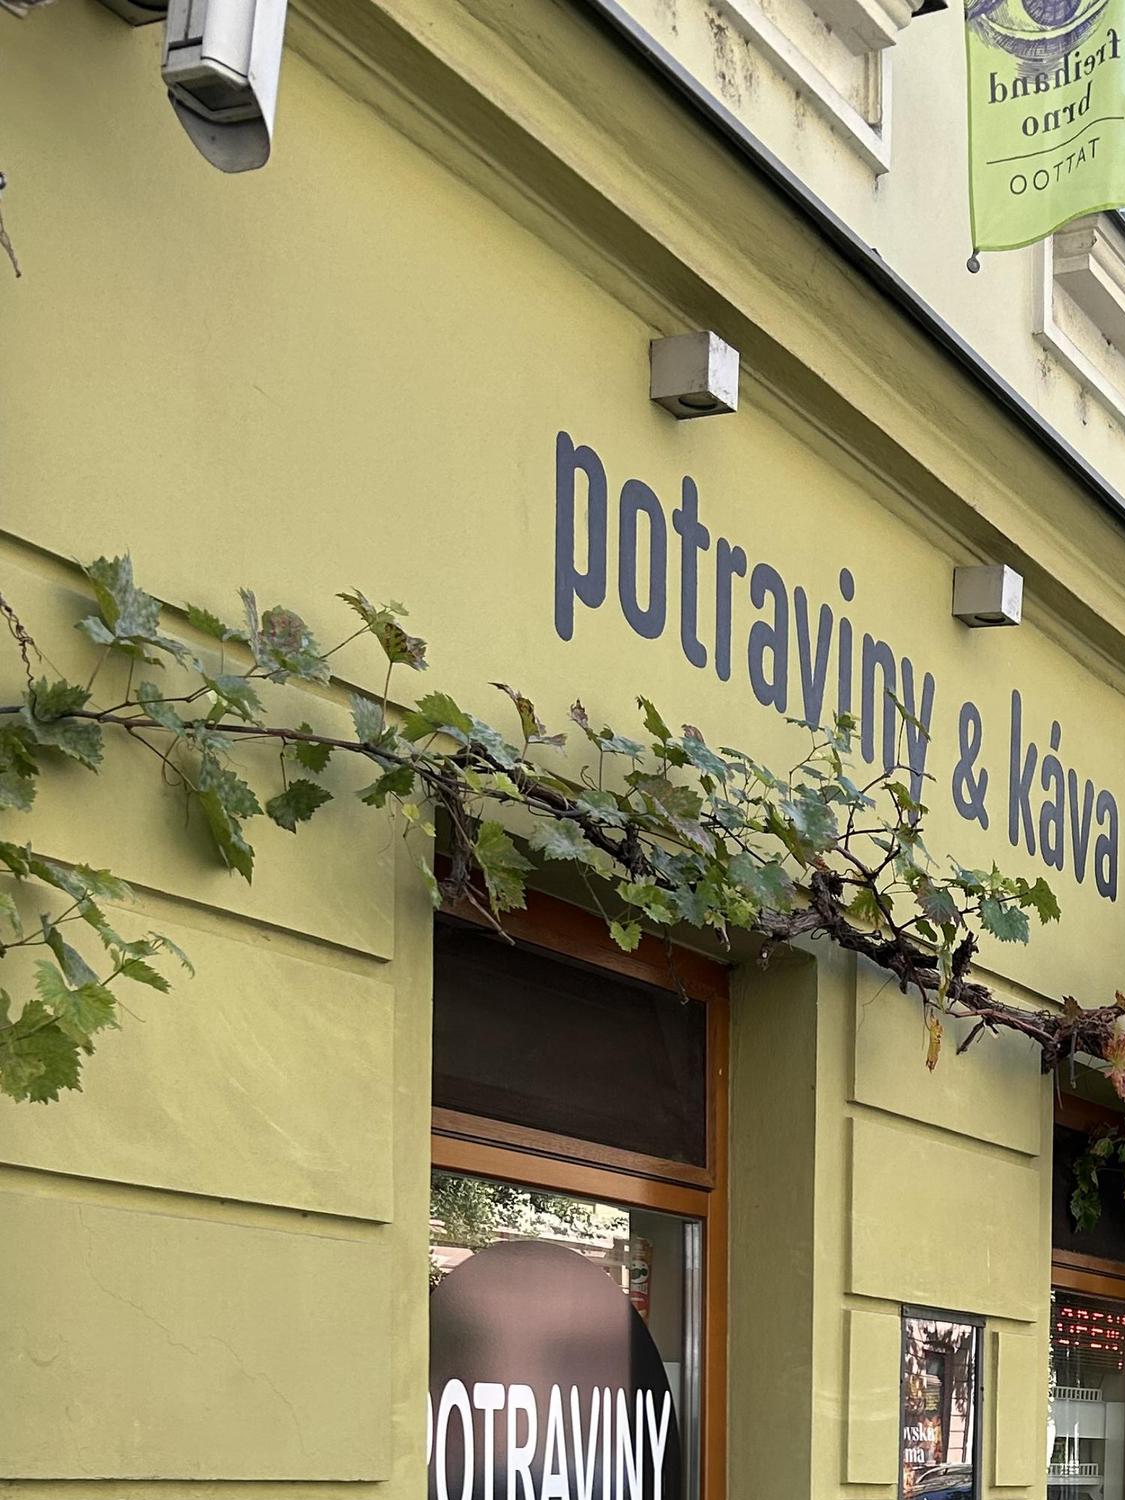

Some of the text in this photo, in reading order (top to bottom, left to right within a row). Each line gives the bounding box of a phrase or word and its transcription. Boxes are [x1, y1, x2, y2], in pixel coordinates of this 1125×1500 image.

[555, 431, 1119, 903] potraviny & káva
